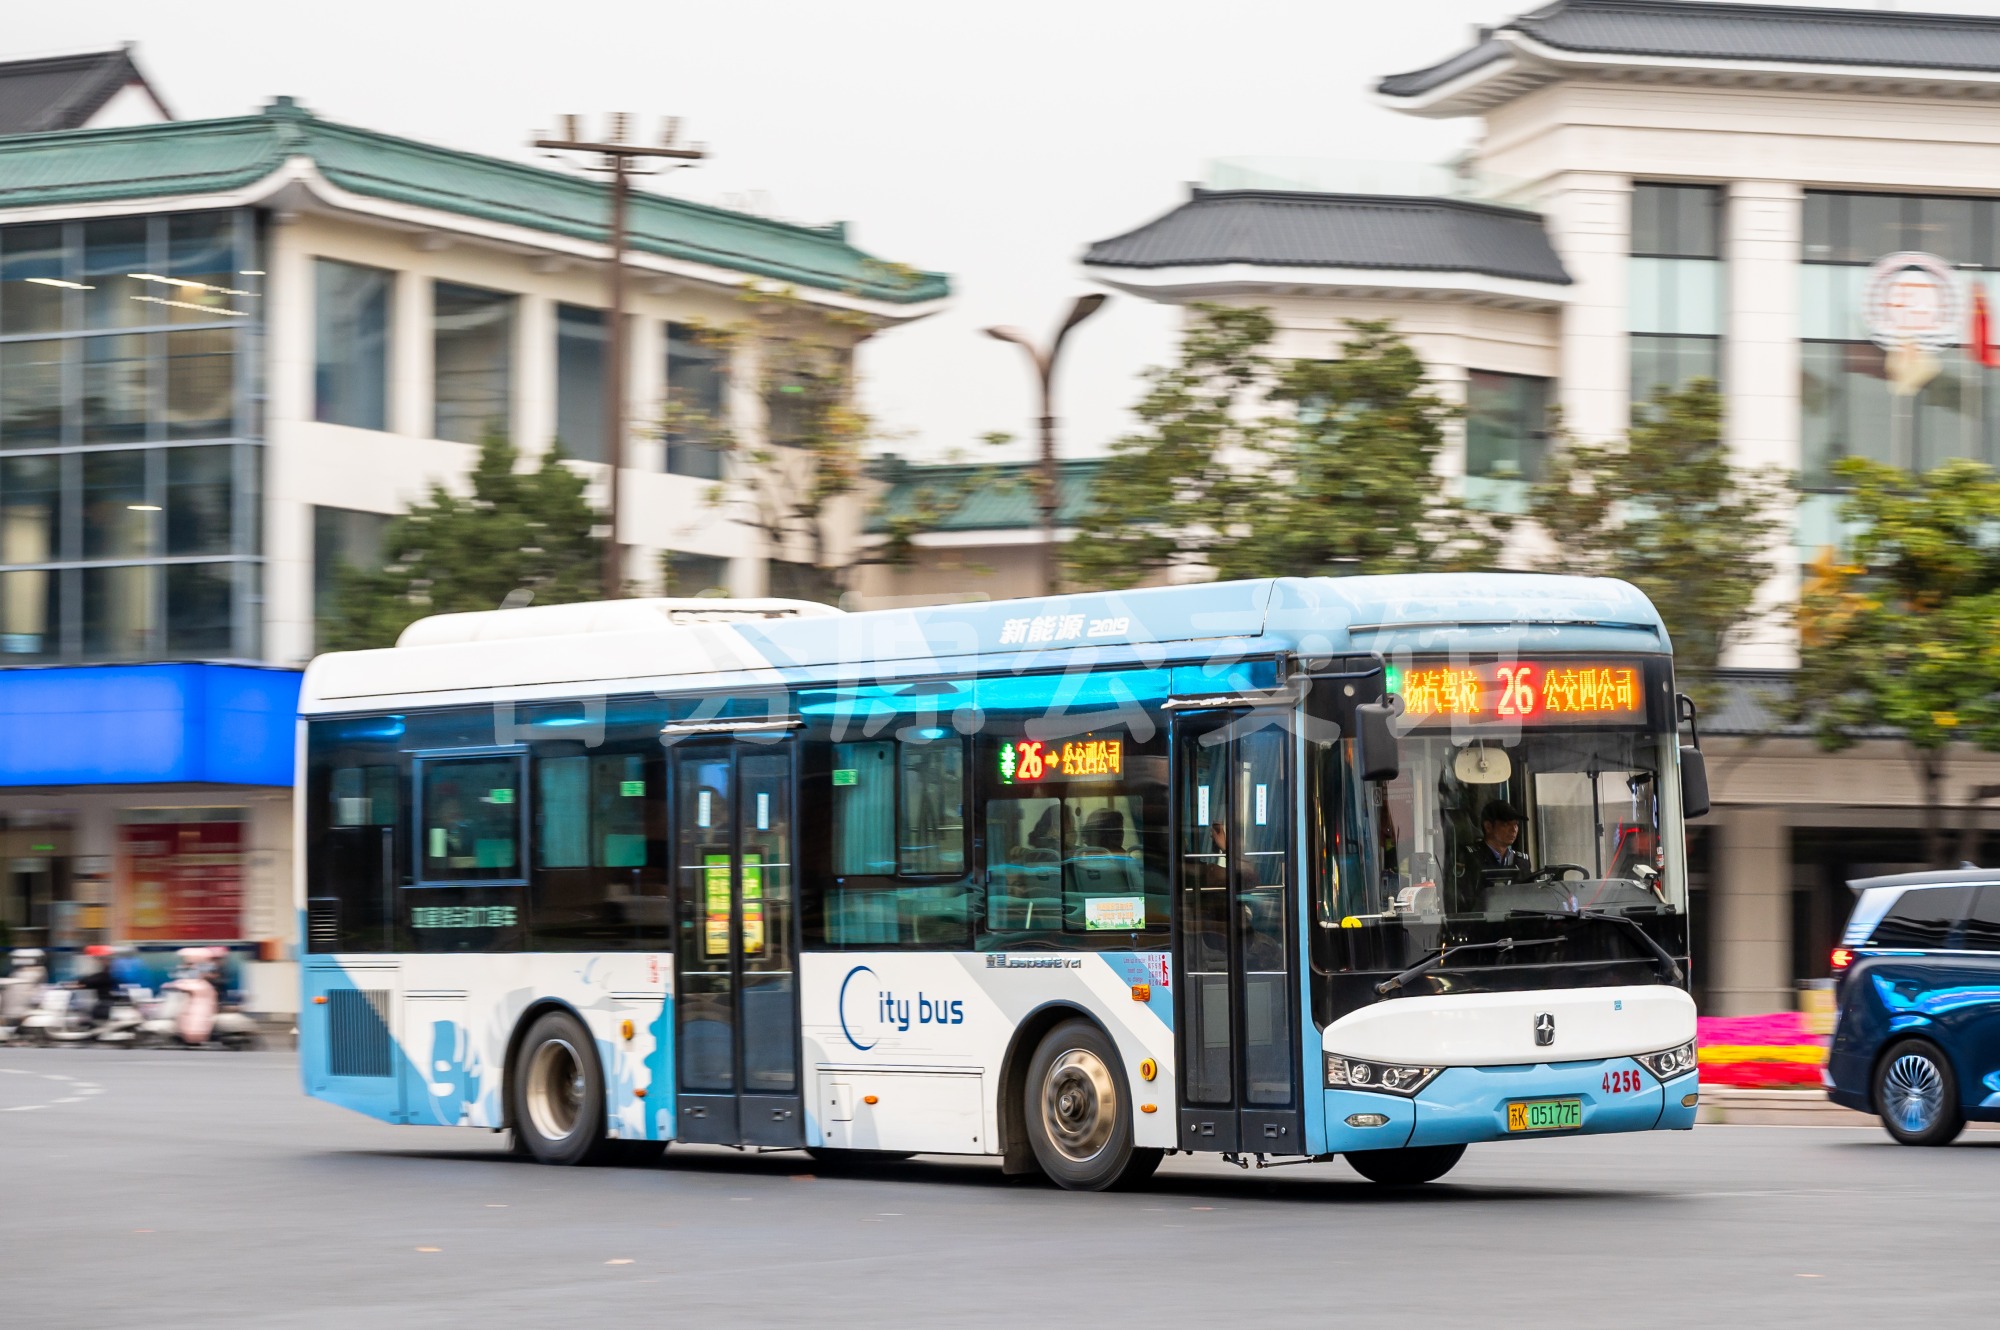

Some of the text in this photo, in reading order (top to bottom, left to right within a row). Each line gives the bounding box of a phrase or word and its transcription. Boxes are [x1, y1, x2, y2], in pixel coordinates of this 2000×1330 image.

[999, 614, 1129, 644] 新能源 2019
[1496, 667, 1534, 715] 26
[1543, 669, 1632, 712] 公交四公司
[1017, 741, 1043, 779] 26
[918, 991, 964, 1024] bus
[1602, 1069, 1641, 1093] 4256
